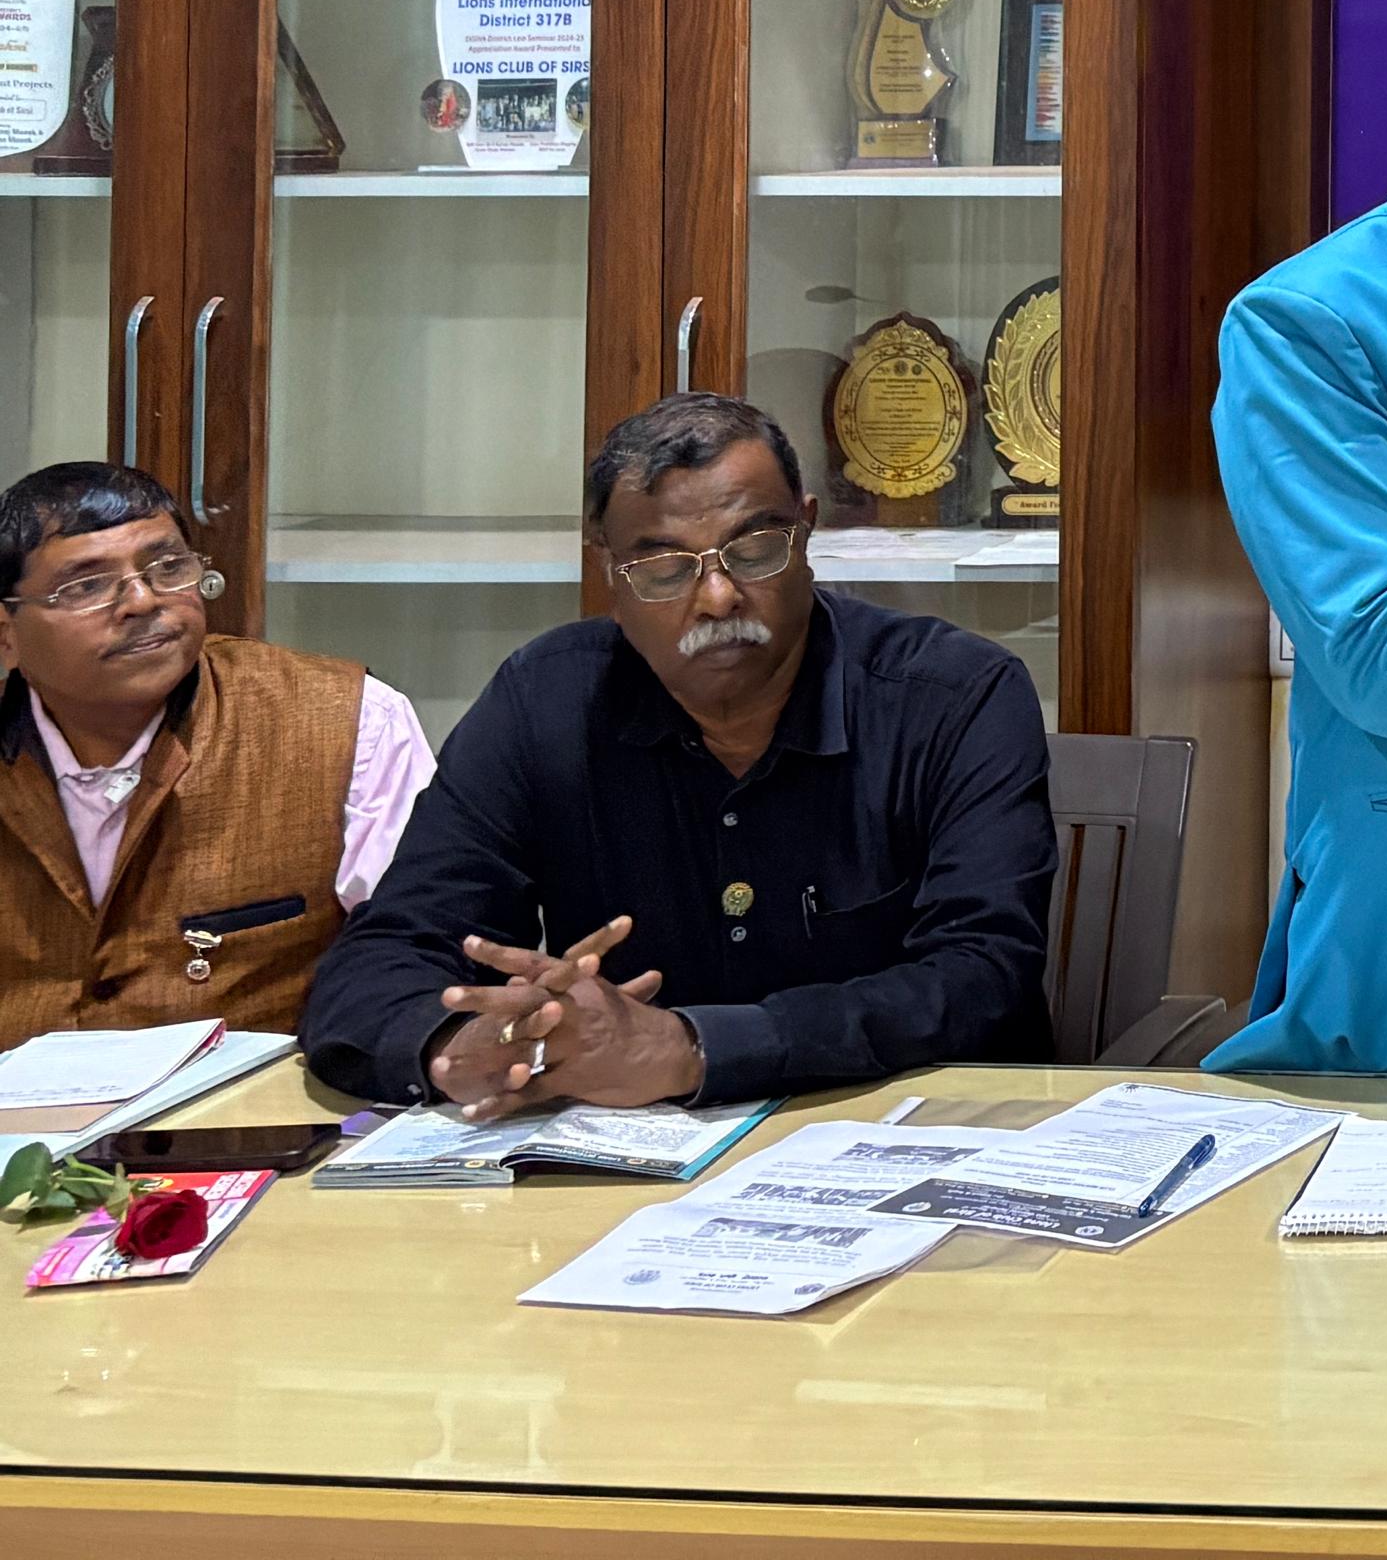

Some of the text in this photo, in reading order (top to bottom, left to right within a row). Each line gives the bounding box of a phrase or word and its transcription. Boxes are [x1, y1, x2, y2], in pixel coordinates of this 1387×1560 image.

[479, 13, 573, 27] District 317B
[453, 61, 493, 74] LIONS
[498, 61, 534, 73] CLUB
[538, 61, 557, 73] OF
